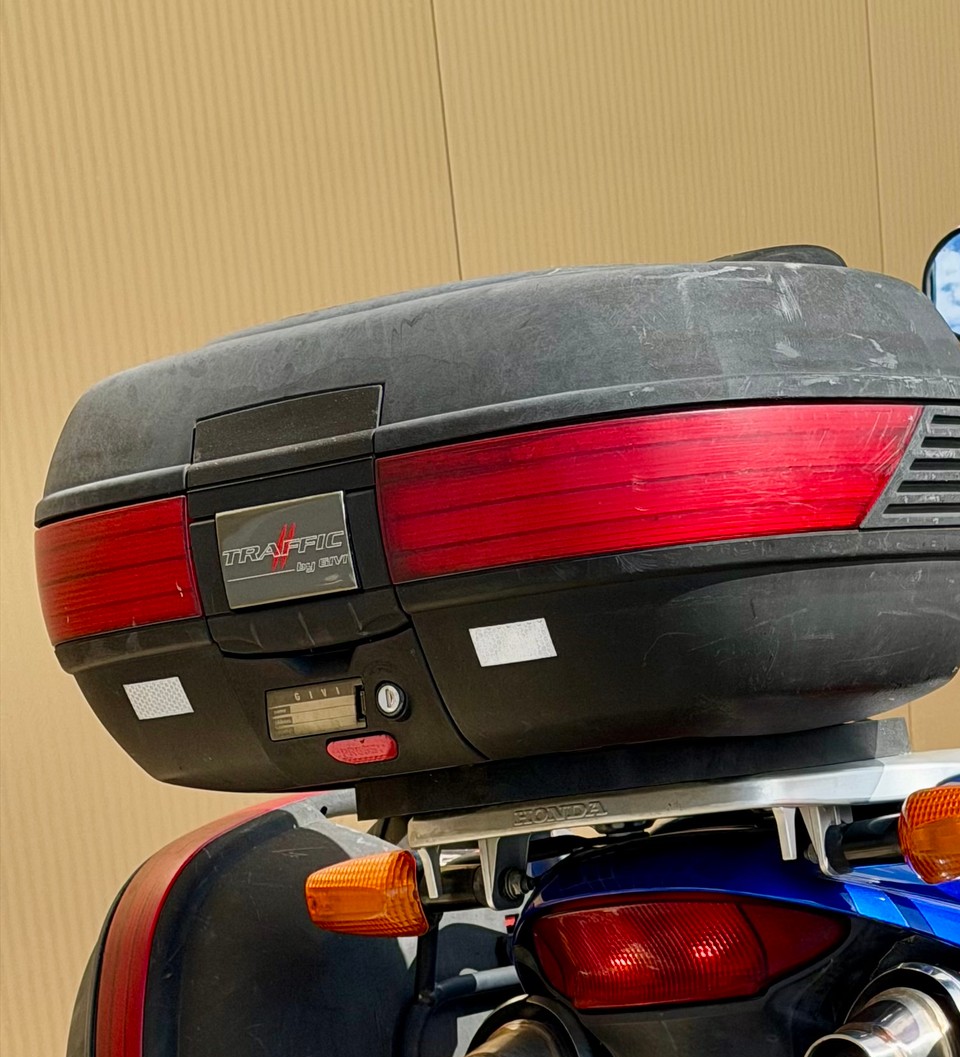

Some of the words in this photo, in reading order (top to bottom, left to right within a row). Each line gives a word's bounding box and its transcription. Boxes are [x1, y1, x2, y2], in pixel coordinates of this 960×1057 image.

[222, 530, 344, 566] TRAFFIC
[296, 562, 316, 573] by
[318, 554, 349, 568] GIVI
[294, 687, 341, 701] GIVI
[513, 801, 608, 826] HONDA
